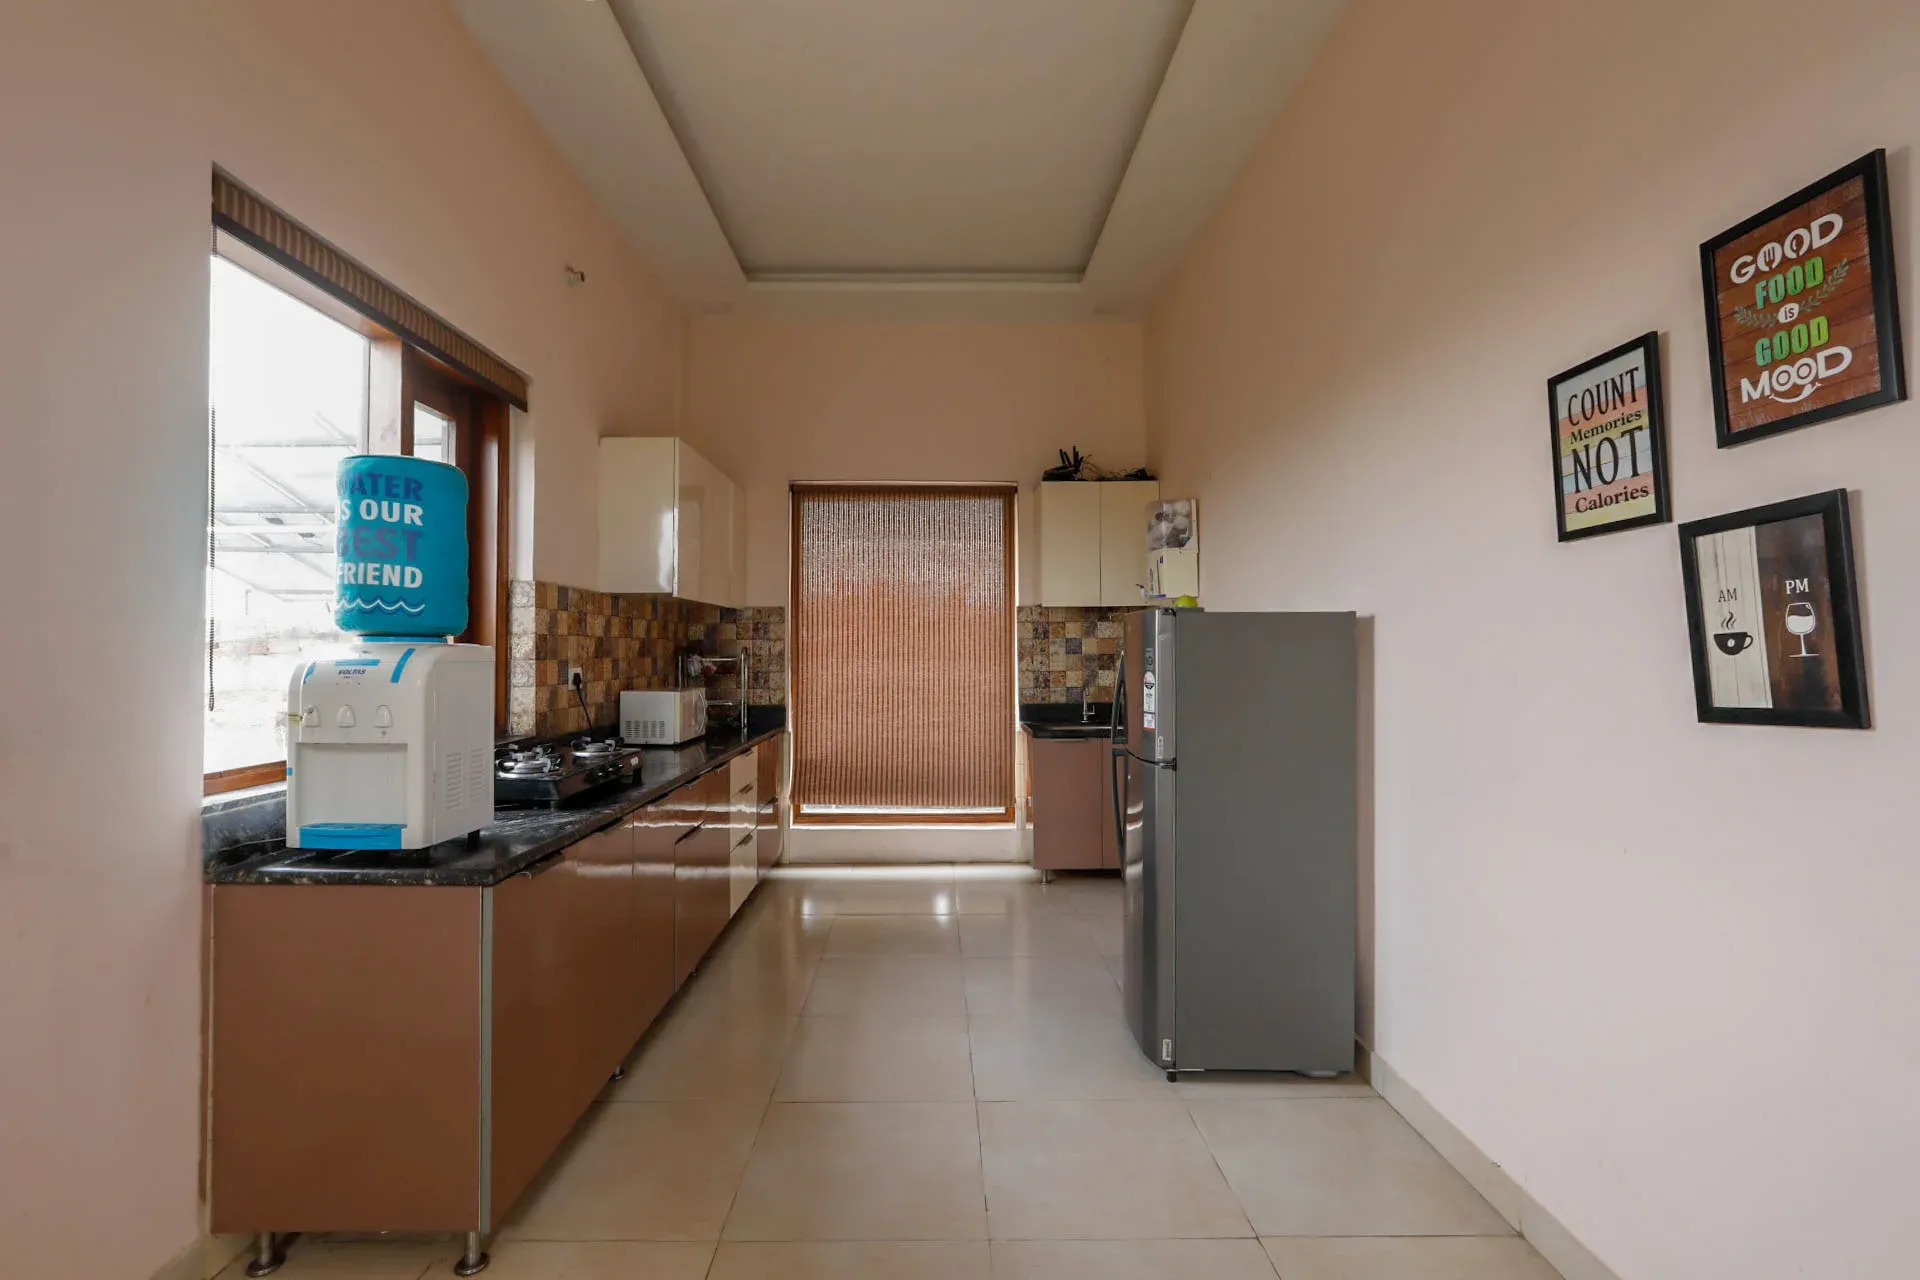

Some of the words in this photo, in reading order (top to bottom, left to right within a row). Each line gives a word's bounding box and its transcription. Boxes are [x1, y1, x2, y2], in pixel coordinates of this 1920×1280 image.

[1730, 213, 1843, 285] GOOD
[1756, 255, 1824, 311] FOOD
[1784, 307, 1795, 320] is
[1755, 315, 1830, 367] GOOD
[1740, 345, 1853, 404] MOOD
[1568, 366, 1640, 427] COUNT
[1569, 409, 1642, 445] Memories
[1572, 425, 1643, 494] NOT
[359, 498, 424, 527] OUR
[1575, 484, 1650, 513] Calories
[336, 561, 423, 588] FRIEND
[1785, 578, 1810, 595] PM
[1718, 588, 1738, 603] AM
